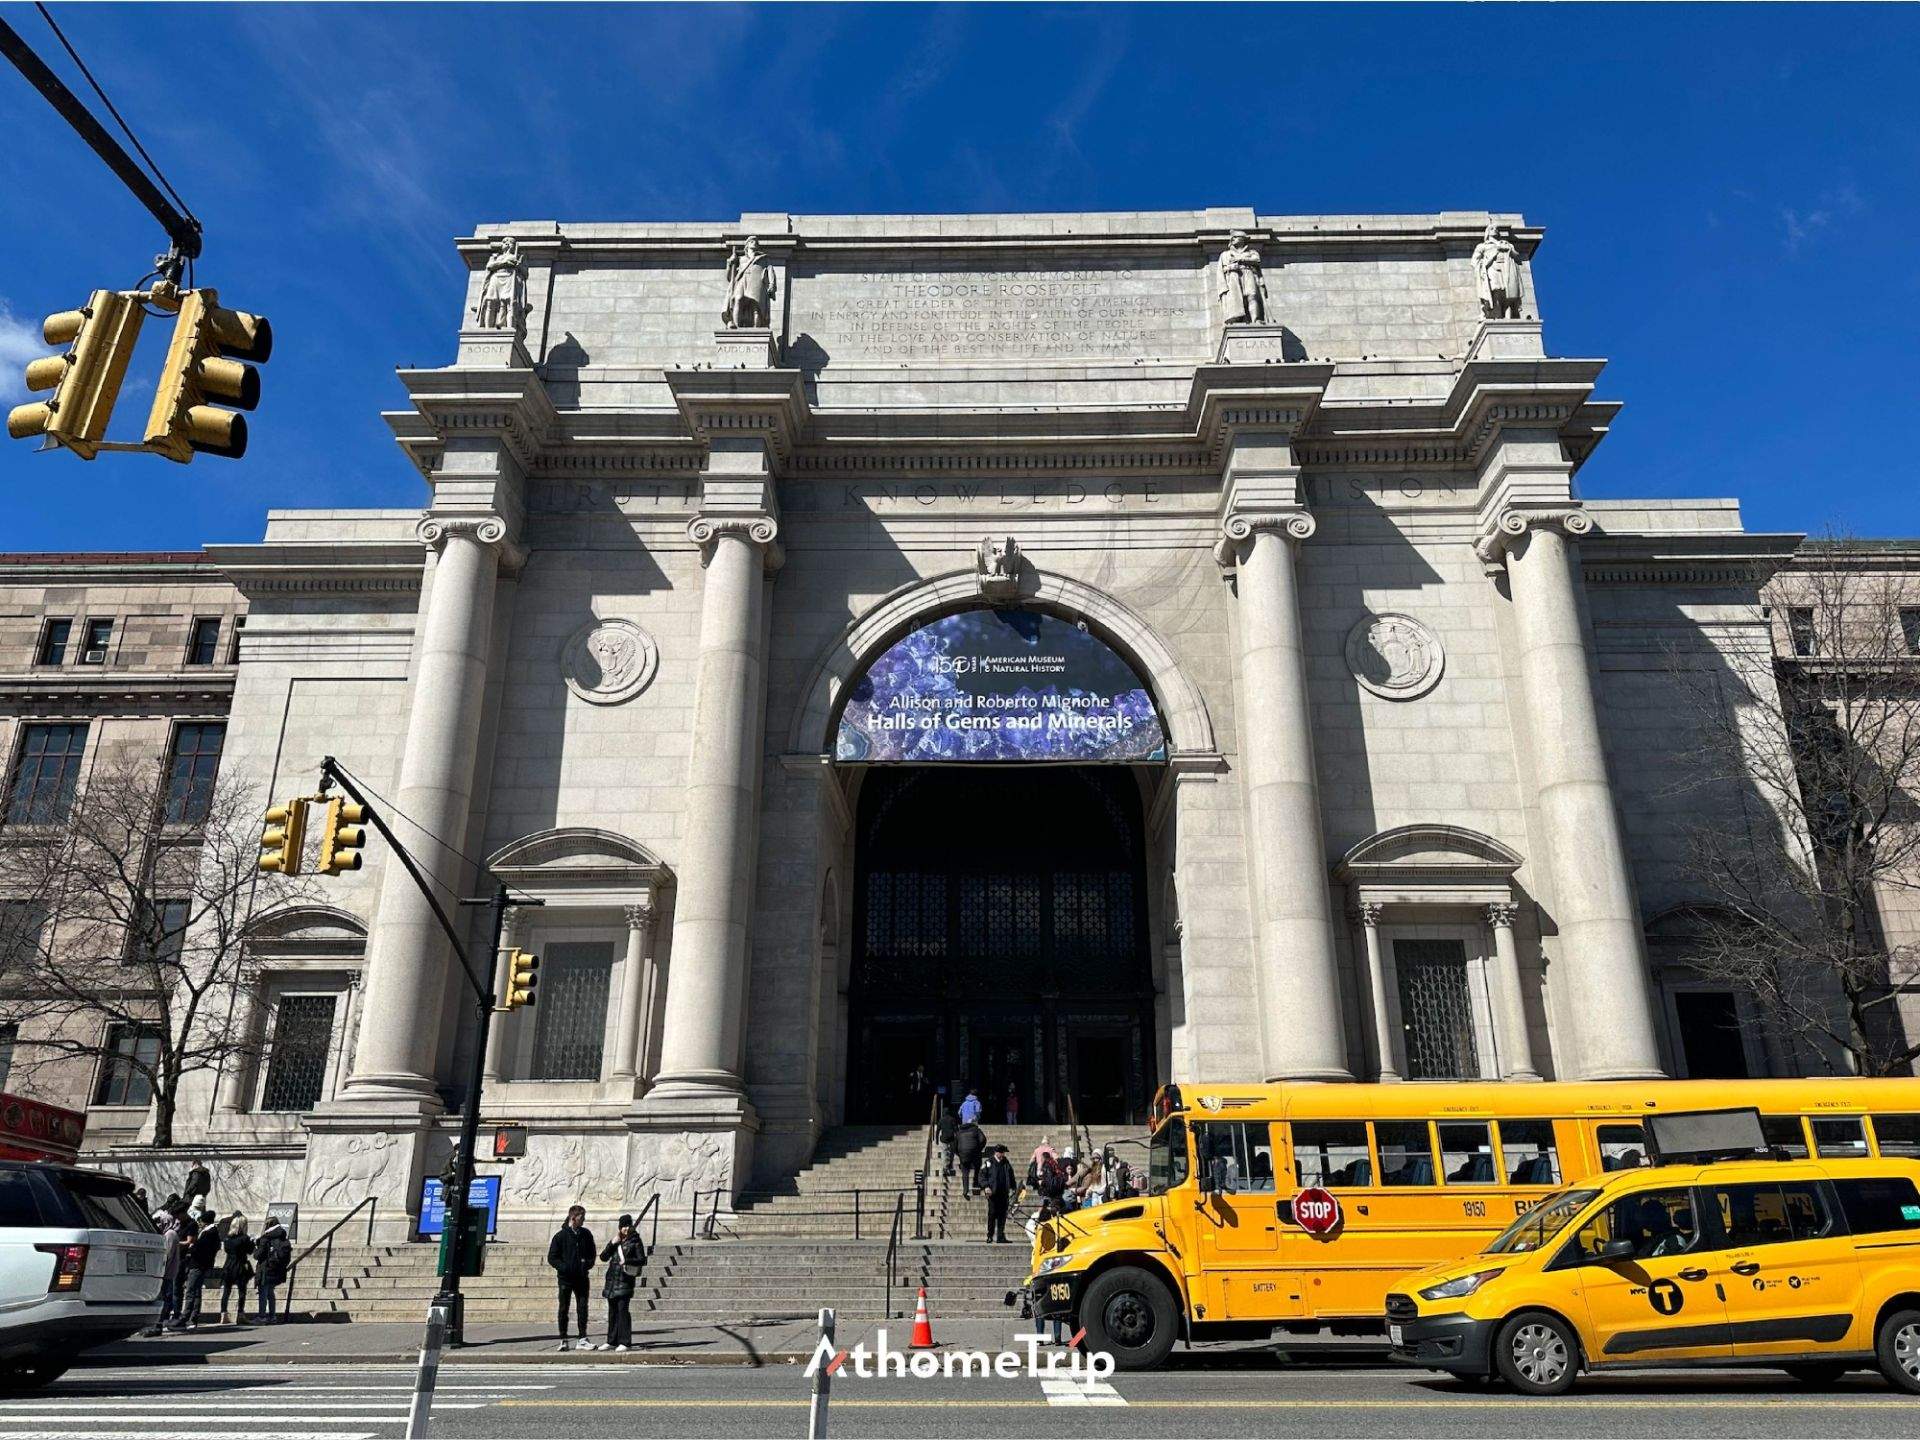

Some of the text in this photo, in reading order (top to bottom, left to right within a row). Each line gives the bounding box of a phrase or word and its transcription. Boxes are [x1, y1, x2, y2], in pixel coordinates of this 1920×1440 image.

[894, 284, 1101, 297] THEODORE ROOSEVELT
[842, 482, 1160, 505] KNOWLEDGE
[1028, 655, 1066, 664] MUSEUM
[992, 664, 1029, 673] NATURAL
[1031, 664, 1066, 673] HISTORY
[889, 695, 1110, 712] Allison and Roberto Mignone
[867, 711, 1133, 730] Halls of Gems and Minerals
[1300, 1201, 1332, 1219] STOP
[1462, 1200, 1486, 1217] 19150
[1050, 1283, 1071, 1301] 19150
[1630, 1287, 1647, 1295] NYC
